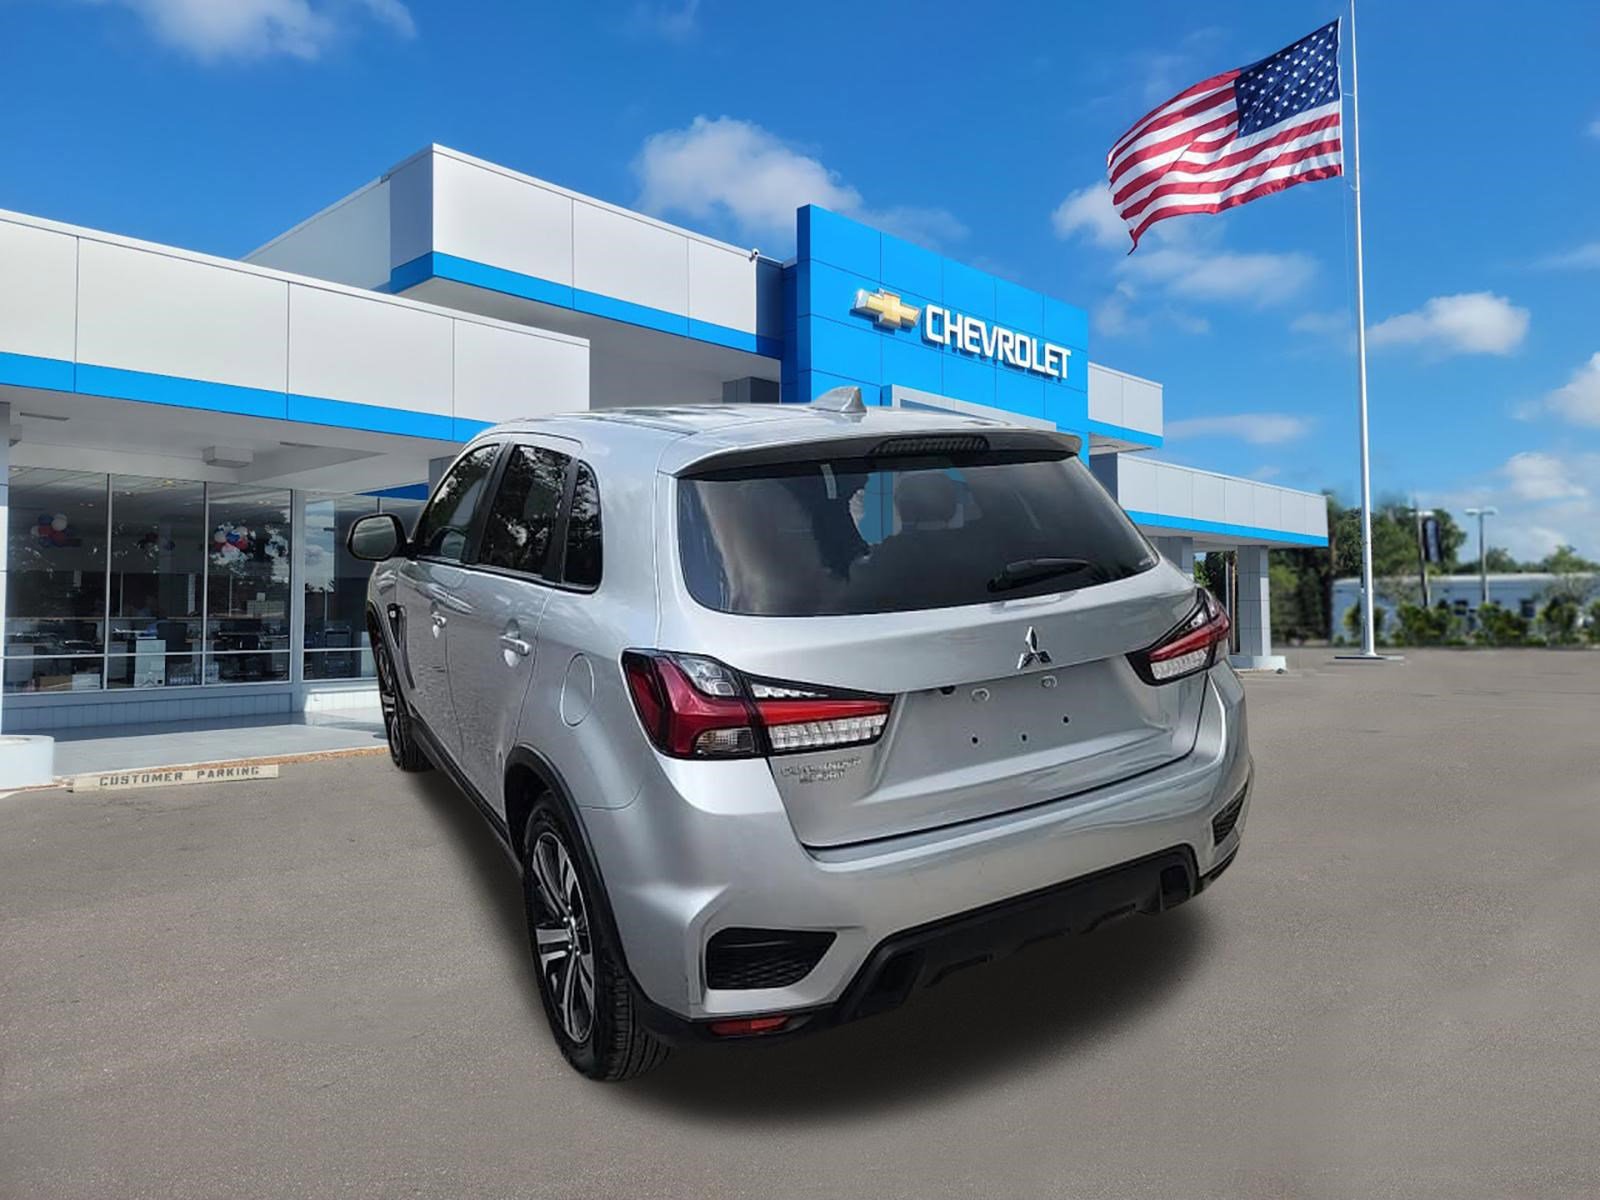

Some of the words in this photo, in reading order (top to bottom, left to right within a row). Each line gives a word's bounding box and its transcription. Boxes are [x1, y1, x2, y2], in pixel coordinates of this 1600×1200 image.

[925, 304, 1072, 379] CHEVROLET
[100, 772, 183, 786] CUSTOMER
[197, 767, 259, 779] PARKING
